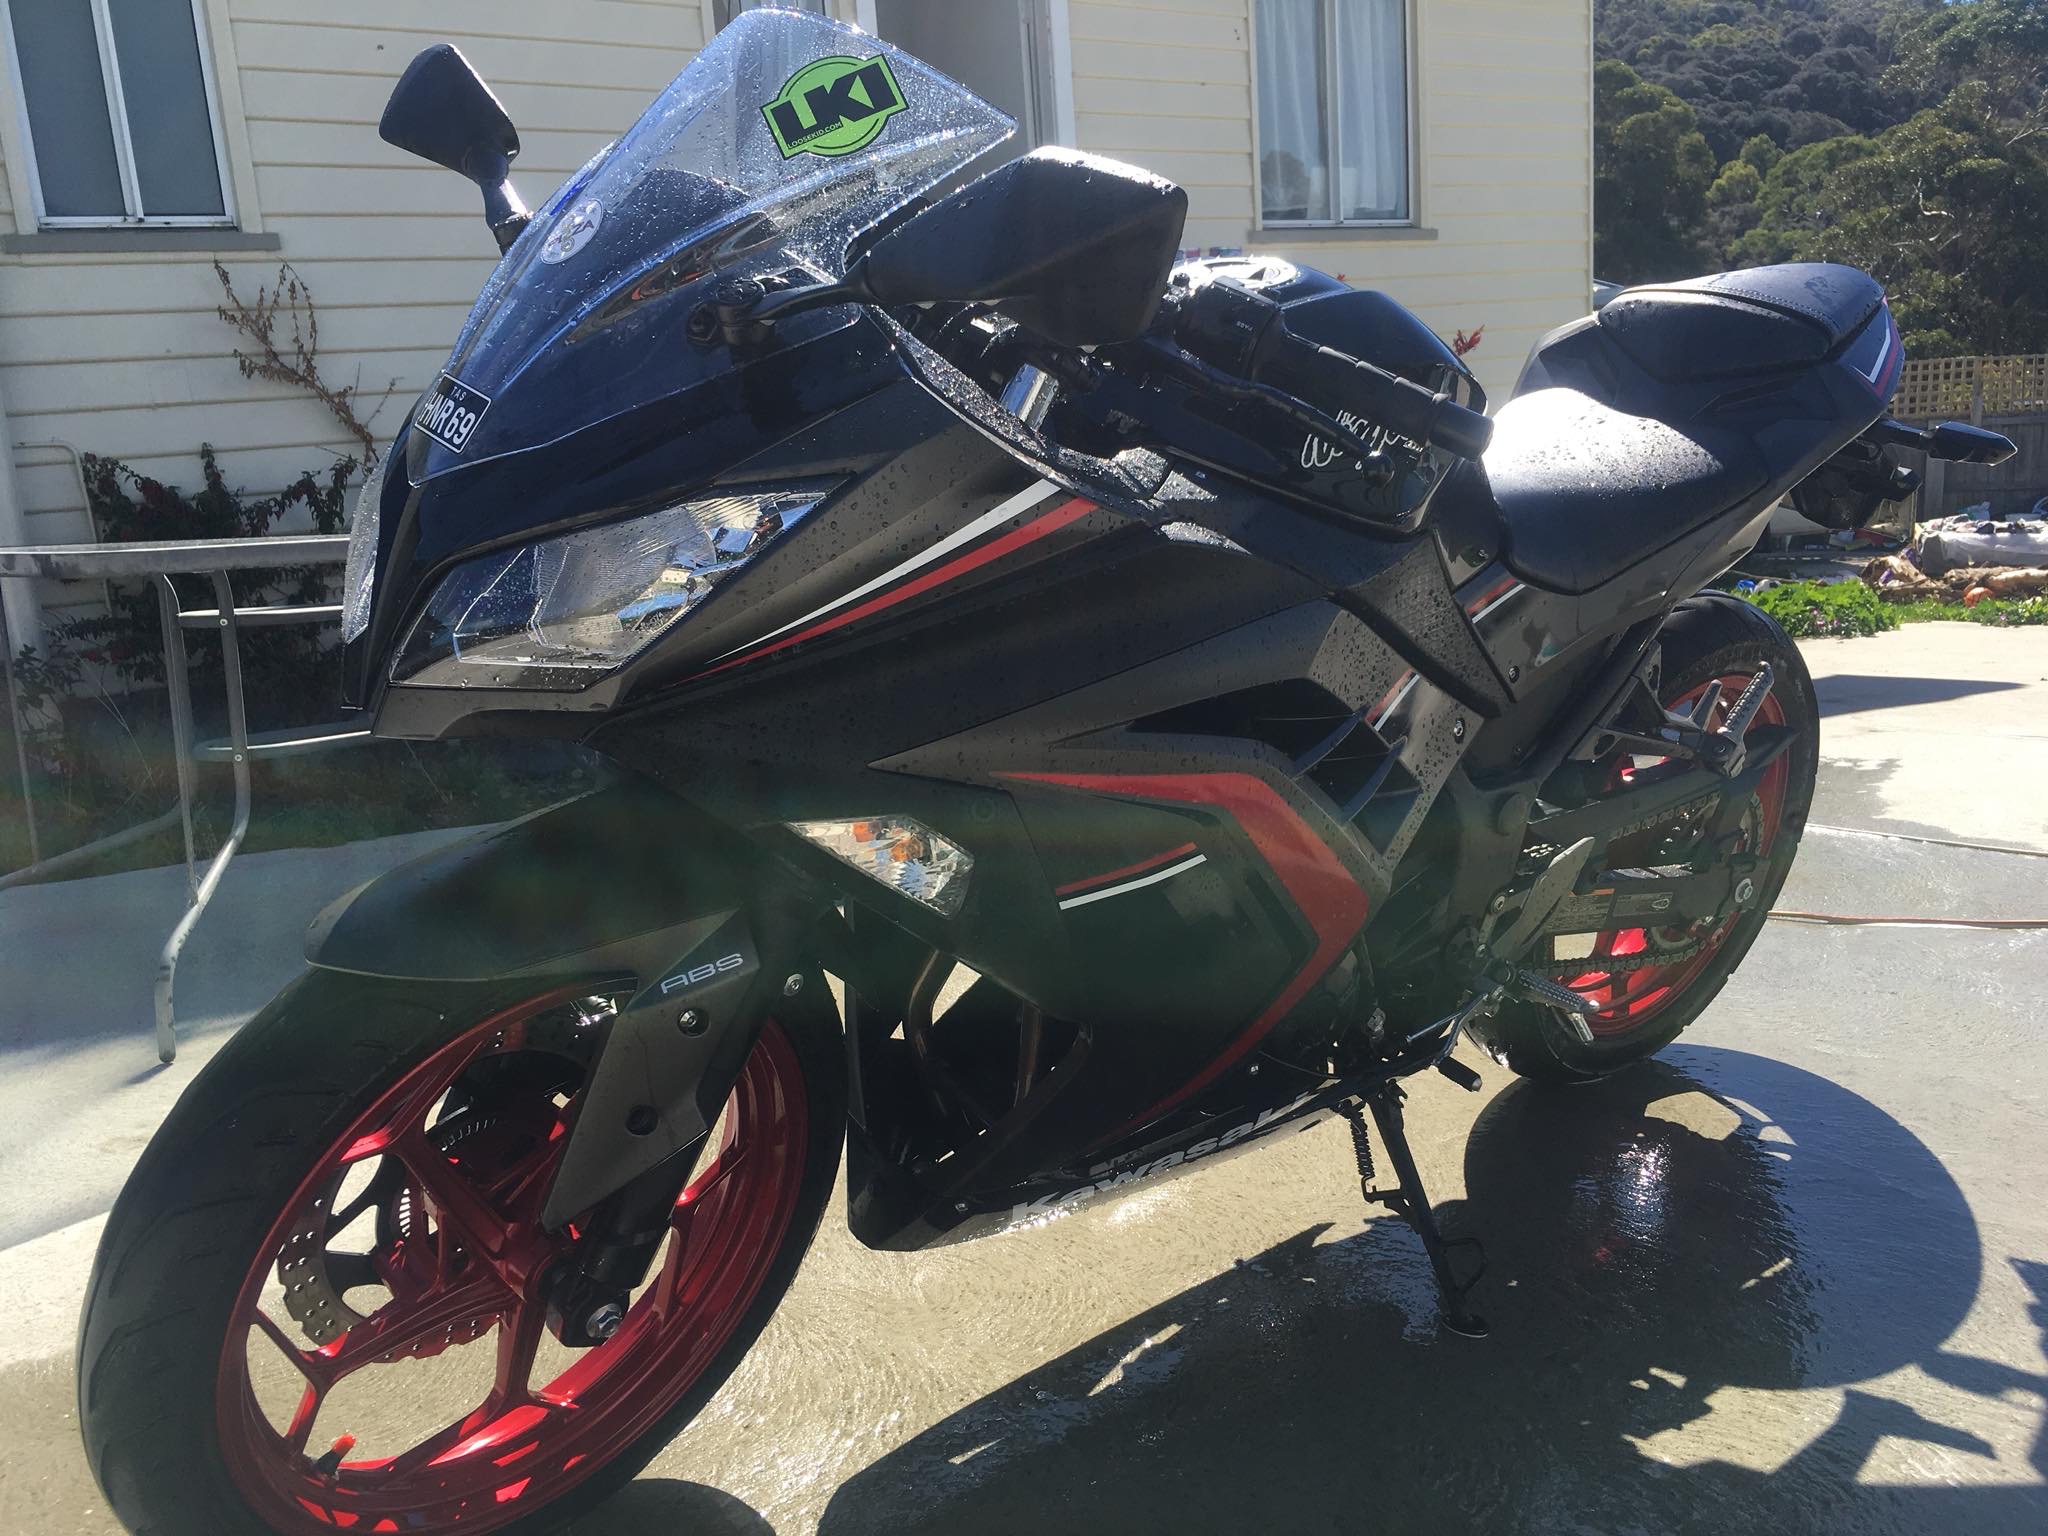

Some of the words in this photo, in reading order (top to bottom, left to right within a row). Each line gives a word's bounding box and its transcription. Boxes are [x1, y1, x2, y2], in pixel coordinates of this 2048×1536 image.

[787, 121, 843, 149] LOOSEKID.COM
[450, 386, 467, 401] TAS
[419, 391, 476, 445] HNR69
[660, 953, 744, 994] ABS
